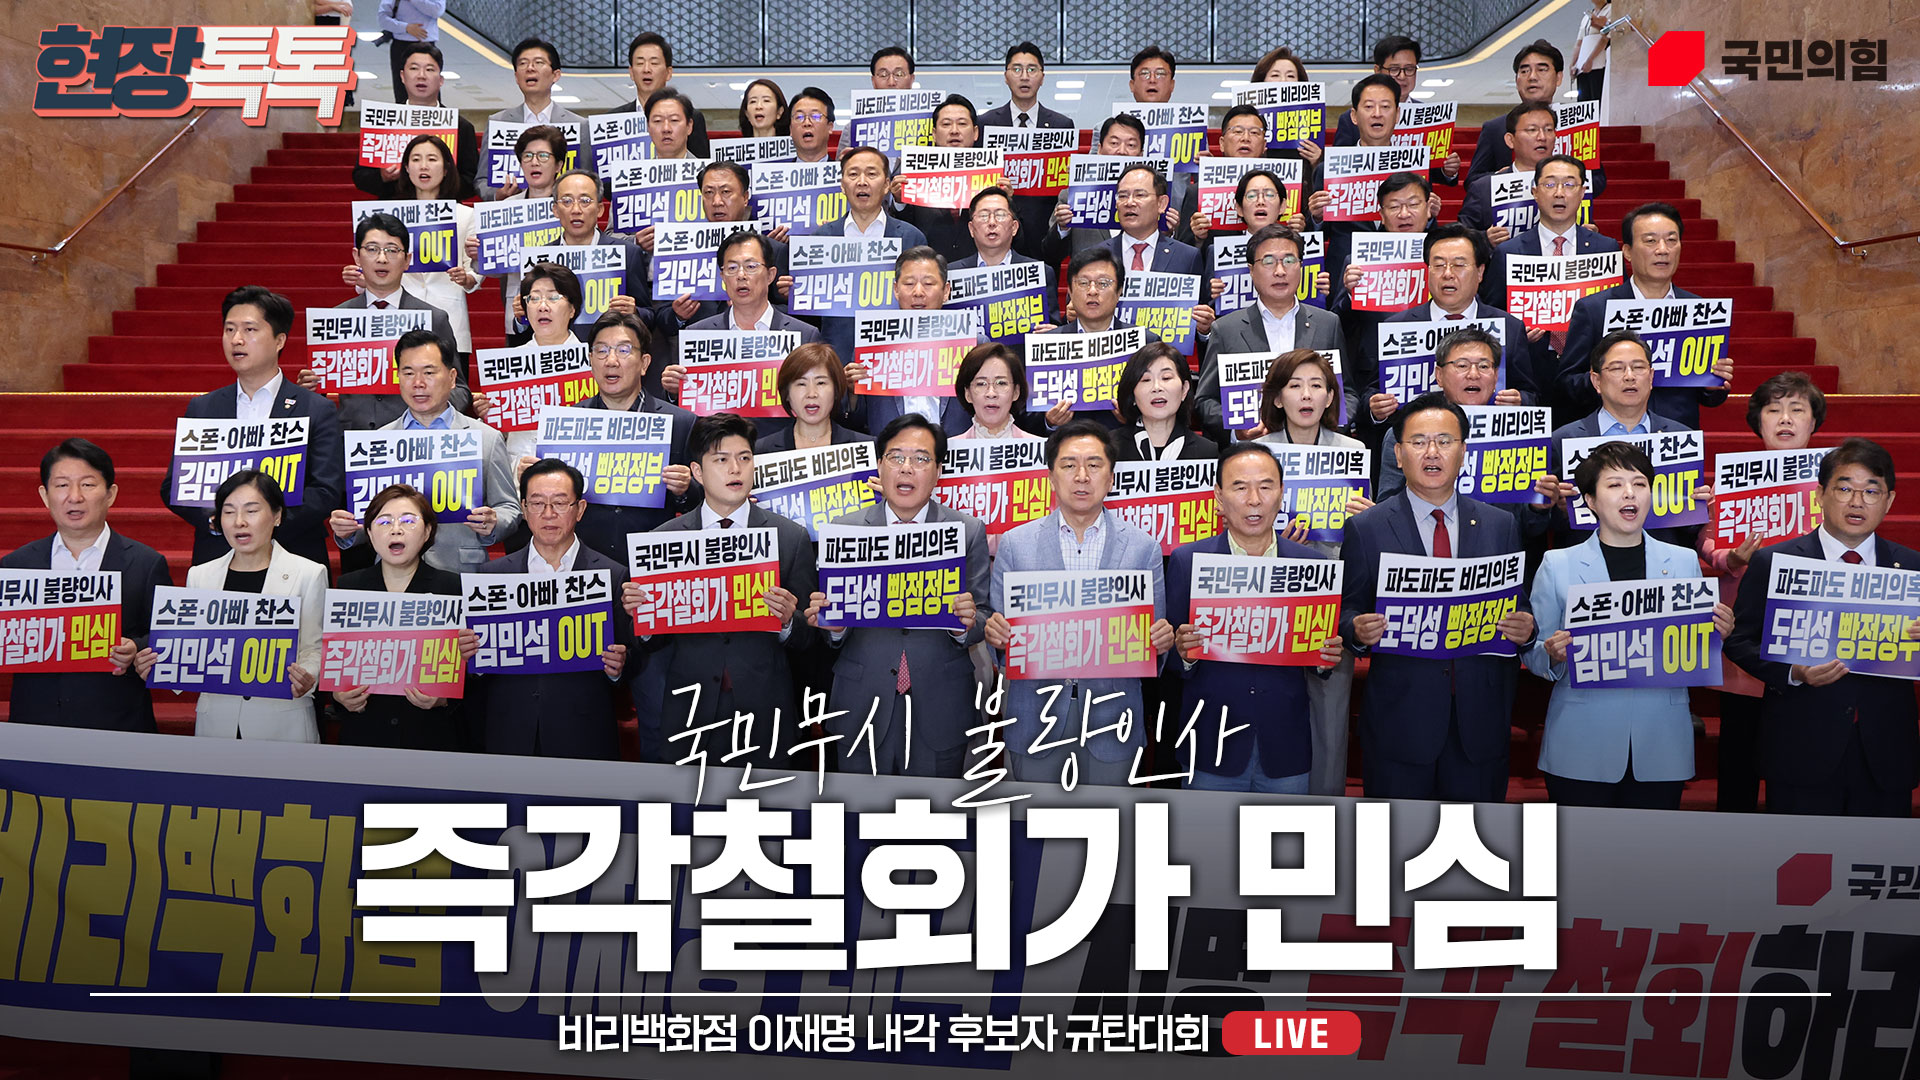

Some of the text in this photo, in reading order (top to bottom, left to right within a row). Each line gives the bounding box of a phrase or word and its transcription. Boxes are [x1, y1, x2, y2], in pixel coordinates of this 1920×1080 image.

[855, 91, 941, 115] 파도파도 비리의혹
[1280, 83, 1321, 104] 비리의혹
[365, 108, 453, 127] 국민무시 불량인사
[1178, 106, 1205, 125] 찬스
[1276, 108, 1322, 142] 빵점정부
[1414, 104, 1453, 126] 불량인사
[1560, 102, 1595, 127] 불량인사
[1032, 131, 1074, 150] 불량인사
[1170, 131, 1204, 164] OUT
[1573, 127, 1597, 160] 민심!
[614, 163, 677, 188] 스폰·아빠
[906, 150, 998, 170] 국민무시 불량인사
[1074, 162, 1121, 182] 파도파도
[1328, 148, 1425, 175] 국민무시 불량인사
[755, 166, 818, 191] 스폰·아빠
[904, 176, 968, 203] 즉각철회가
[425, 202, 453, 222] 찬스
[617, 191, 670, 230] 김민석
[756, 195, 811, 235] 김민석
[1071, 190, 1113, 224] 도덕성
[1326, 180, 1381, 217] 즉각철회
[480, 205, 524, 229] 파도파도
[420, 230, 454, 264] OUT
[482, 232, 521, 271] 도덕성
[657, 226, 726, 253] 스폰·아빠
[792, 239, 898, 267] 스폰·아빠 찬스
[1357, 239, 1408, 262] 국민무시
[592, 247, 622, 270] 찬스
[1511, 254, 1617, 283] 국민무시 불량인사
[657, 257, 718, 297] 김민석
[793, 270, 896, 311] 김민석 OUT
[949, 264, 1040, 300] 도파도 비리의혹
[1143, 275, 1195, 298] 비리의혹
[1351, 268, 1426, 307] 즉각철회가
[312, 315, 367, 340] 국민무시
[860, 316, 913, 343] 국민무시
[917, 313, 971, 339] 불량인사
[989, 294, 1045, 339] 빵점정부
[1608, 301, 1727, 332] 스폰·아빠 찬스
[684, 334, 796, 363] 국민무시 불량인사
[1031, 329, 1140, 363] 파도파도 비리의혹
[1679, 334, 1725, 376] OUT
[311, 347, 389, 390] 즉각철회가
[483, 354, 536, 381] 국민무시
[858, 347, 934, 391] 즉각철회가
[682, 368, 758, 412] 즉각철회가
[1032, 369, 1078, 407] 도덕성
[180, 420, 304, 451] 스폰·아빠 찬스
[543, 415, 666, 441] 파도파도 비리의혹
[1491, 410, 1546, 437] 비리의혹
[350, 432, 478, 467] 스폰·아빠 찬스
[941, 447, 985, 475] 민무시
[1305, 450, 1364, 476] 비리의혹
[1660, 434, 1699, 461] 찬스
[594, 451, 664, 495] 빵점정부
[752, 444, 870, 490] 파도파도 비리의혹
[1155, 462, 1216, 492] 불량인사
[1480, 446, 1548, 494] 빵점정부
[1721, 456, 1778, 489] 국민무시
[431, 468, 478, 513] OUT
[1012, 476, 1051, 523] 민심!
[1652, 469, 1699, 517] OUT
[1179, 497, 1218, 544] 민심!
[1718, 491, 1805, 544] 즉각철회가
[635, 531, 771, 571] 국민무시 불량인사
[825, 526, 959, 563] 파도파도 비리의혹
[44, 574, 113, 605] 불량인사
[1198, 564, 1337, 594] 국민무시 불량인사
[1385, 555, 1520, 593] 파도파도 비리의혹
[1776, 567, 1846, 599] 파도파도
[468, 572, 607, 612] 스폰·아빠 찬스
[636, 575, 729, 630] 즉각철회가
[825, 566, 961, 621] 도덕성 빵점정부
[1010, 574, 1147, 611] 국민무시 불량인사
[1569, 581, 1715, 624] 스폰·아빠 찬스
[156, 598, 296, 626] 스폰·아빠 찬스
[330, 600, 463, 628] 국민무시 불량인사
[1192, 602, 1337, 655] 즉각철회가 민심!
[1379, 604, 1444, 650] 도덕성
[71, 612, 117, 661] 민심!
[474, 611, 608, 668] 김민석 OUT
[1009, 612, 1151, 674] 즉각철회가 민심!
[1768, 608, 1834, 659] 도덕성
[153, 637, 293, 685] 김민석 OUT
[323, 637, 462, 687] 즉각철회가 민심!
[1572, 621, 1715, 684] 김민석 OUT
